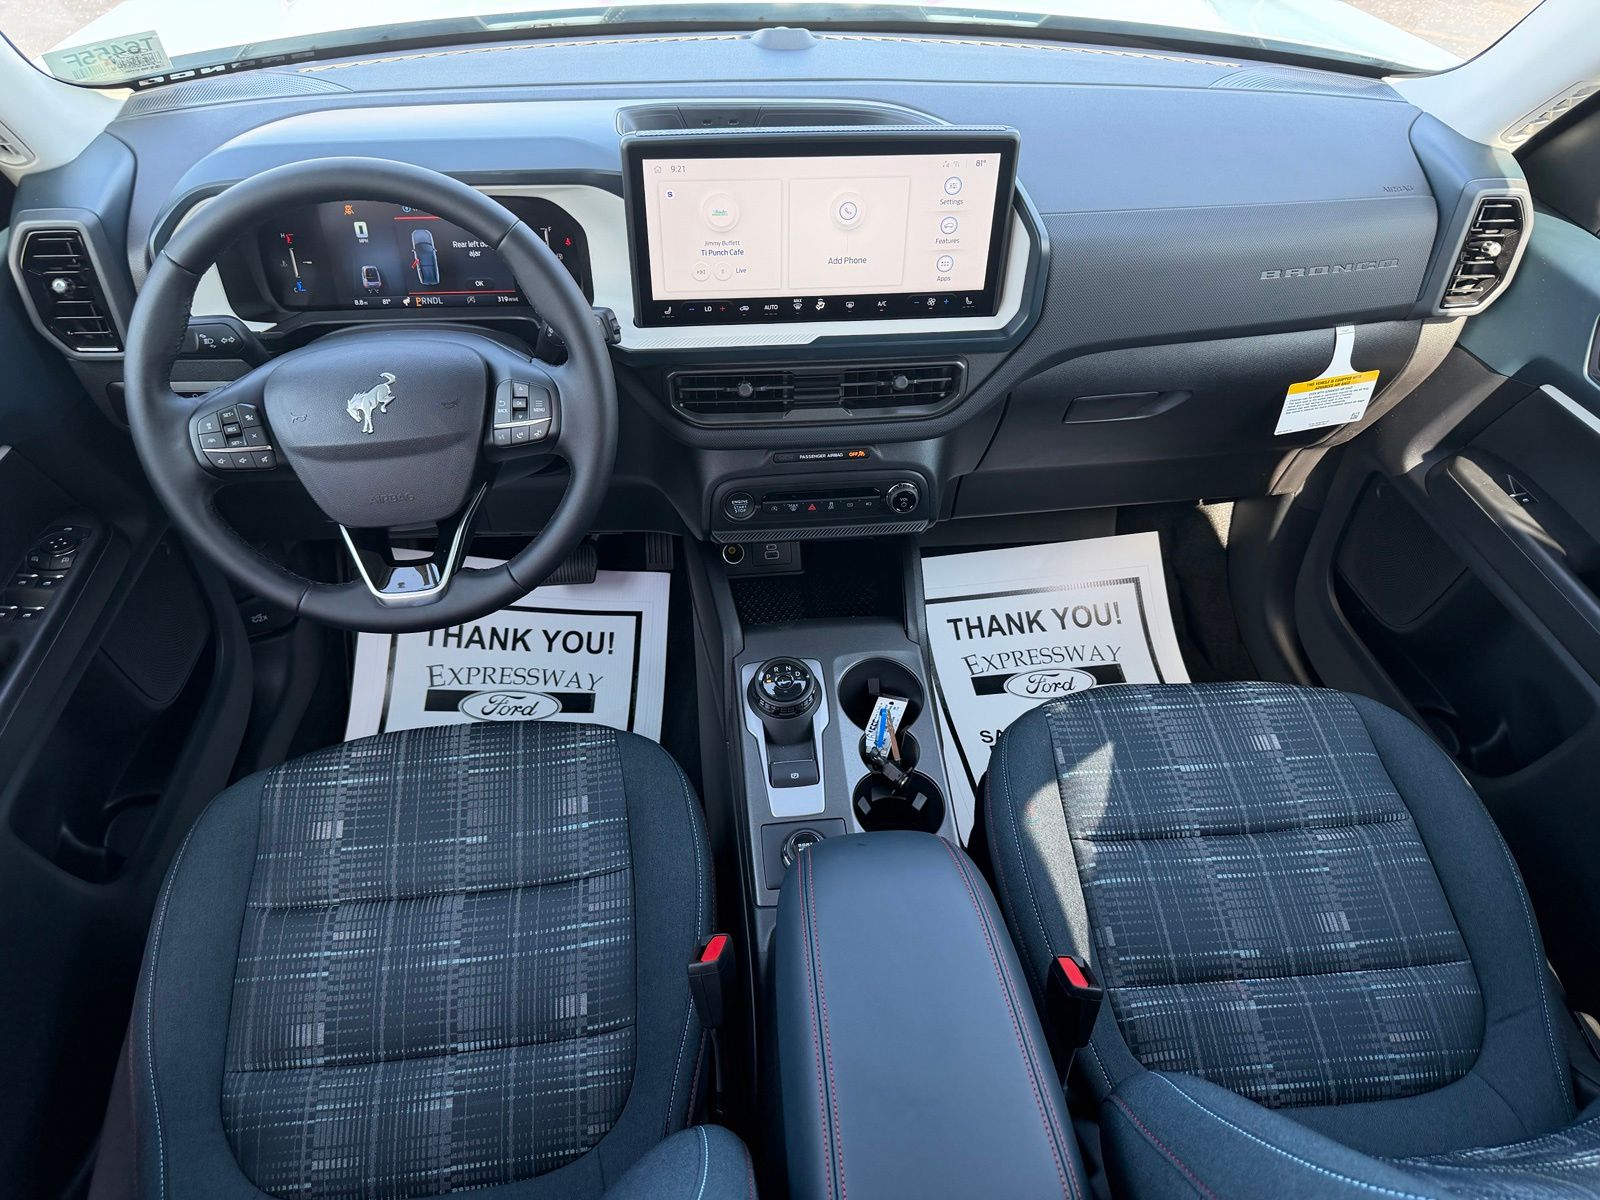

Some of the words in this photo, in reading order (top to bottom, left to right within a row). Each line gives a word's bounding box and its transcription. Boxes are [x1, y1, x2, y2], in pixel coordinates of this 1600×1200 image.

[828, 257, 843, 265] Add
[844, 256, 868, 264] Phone
[1260, 258, 1400, 280] BRONCO
[946, 609, 1047, 641] THANK
[1051, 602, 1122, 631] YOU!
[428, 624, 533, 652] THANK
[542, 629, 615, 656] YOU!
[961, 644, 1122, 676] EXPRESSWAY
[426, 663, 604, 692] EXPRESSWAY
[1026, 673, 1076, 695] Ford
[480, 693, 540, 717] Ford
